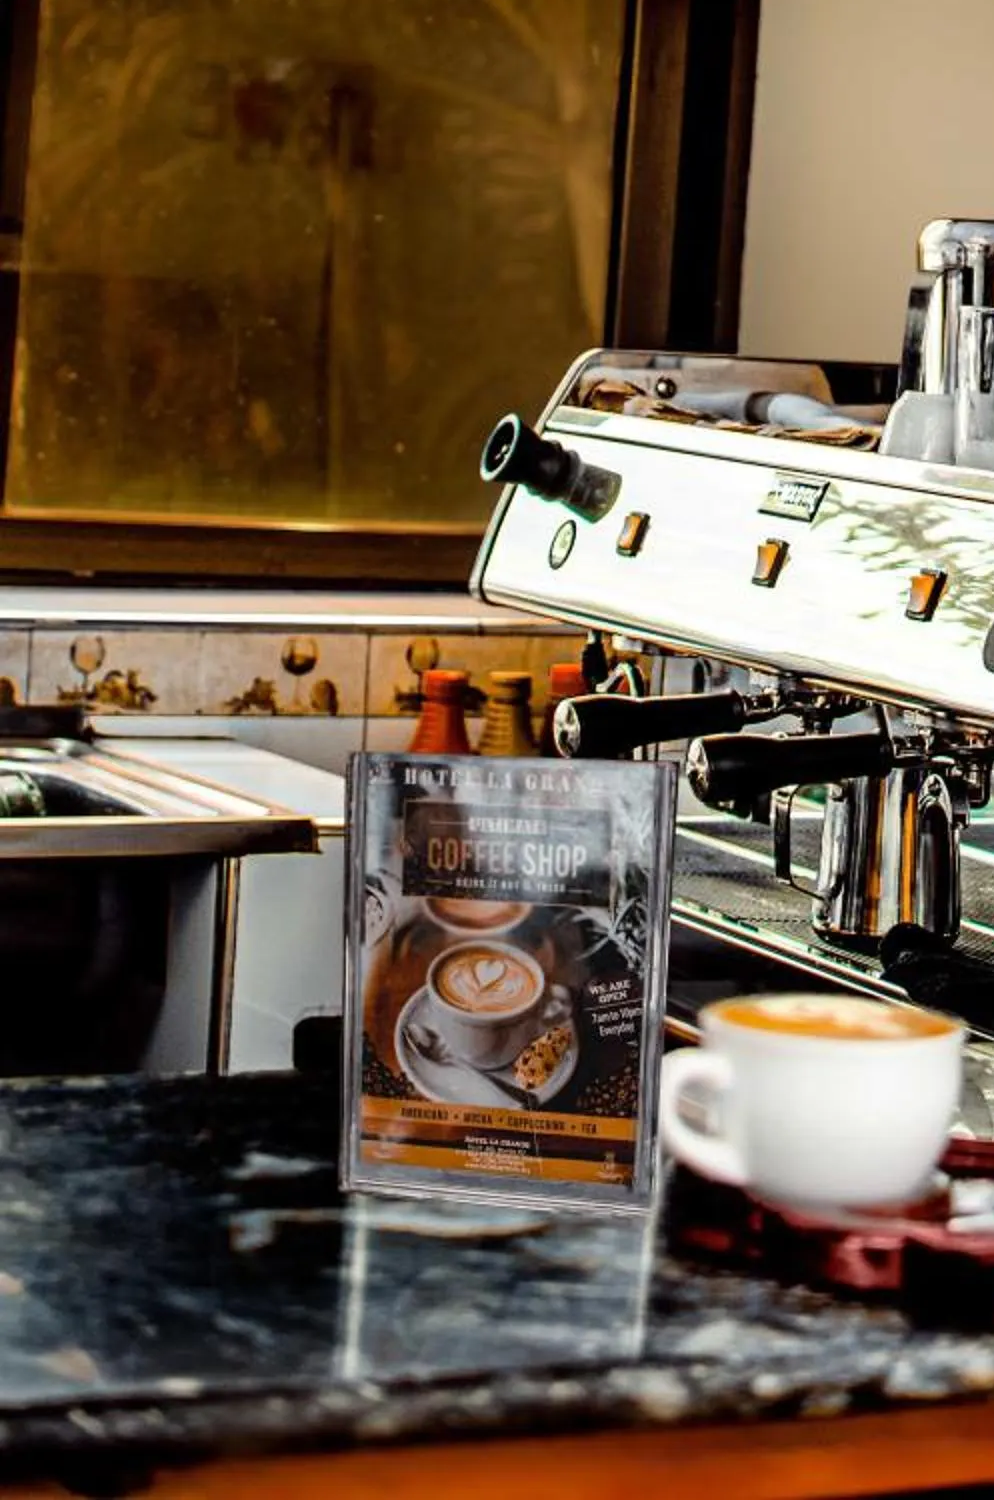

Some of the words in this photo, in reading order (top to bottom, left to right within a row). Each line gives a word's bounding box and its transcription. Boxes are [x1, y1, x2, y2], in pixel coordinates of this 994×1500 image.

[404, 767, 475, 787] HOTEL
[487, 771, 512, 790] LA
[525, 772, 612, 796] GRAN
[427, 837, 517, 876] COFFEE
[521, 842, 588, 879] SHOP
[609, 979, 631, 992] ARE
[598, 989, 628, 1004] OPEN
[581, 1123, 597, 1135] TEA
